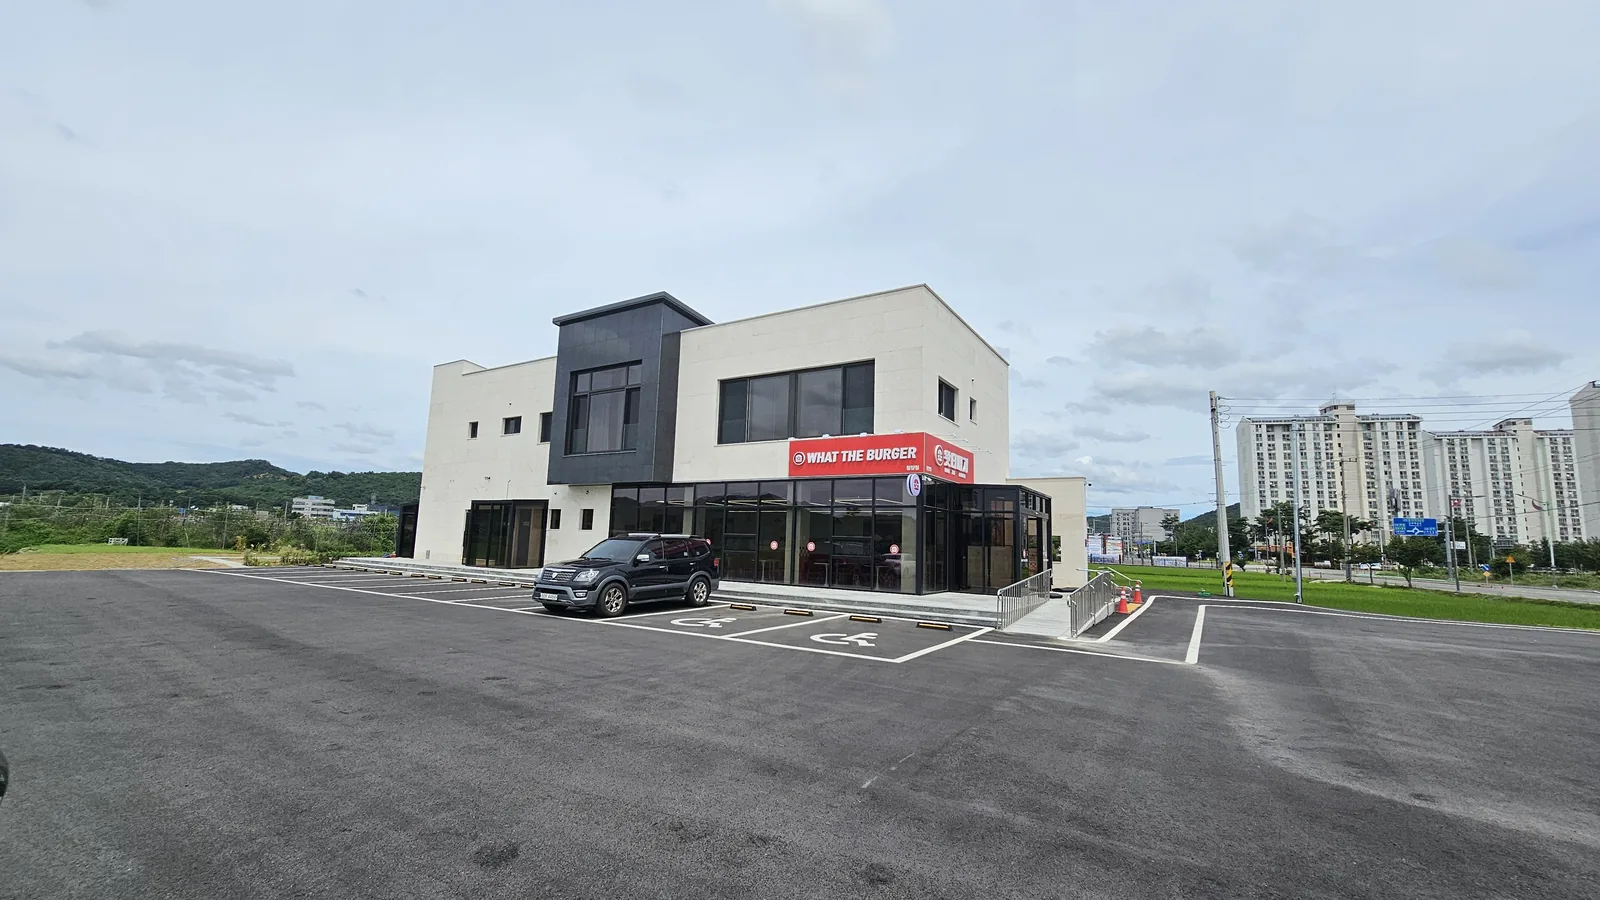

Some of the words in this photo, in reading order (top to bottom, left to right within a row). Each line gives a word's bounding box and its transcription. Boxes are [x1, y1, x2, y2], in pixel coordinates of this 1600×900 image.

[807, 451, 839, 464] WHAT
[841, 450, 864, 462] THE
[866, 446, 917, 461] BURGER
